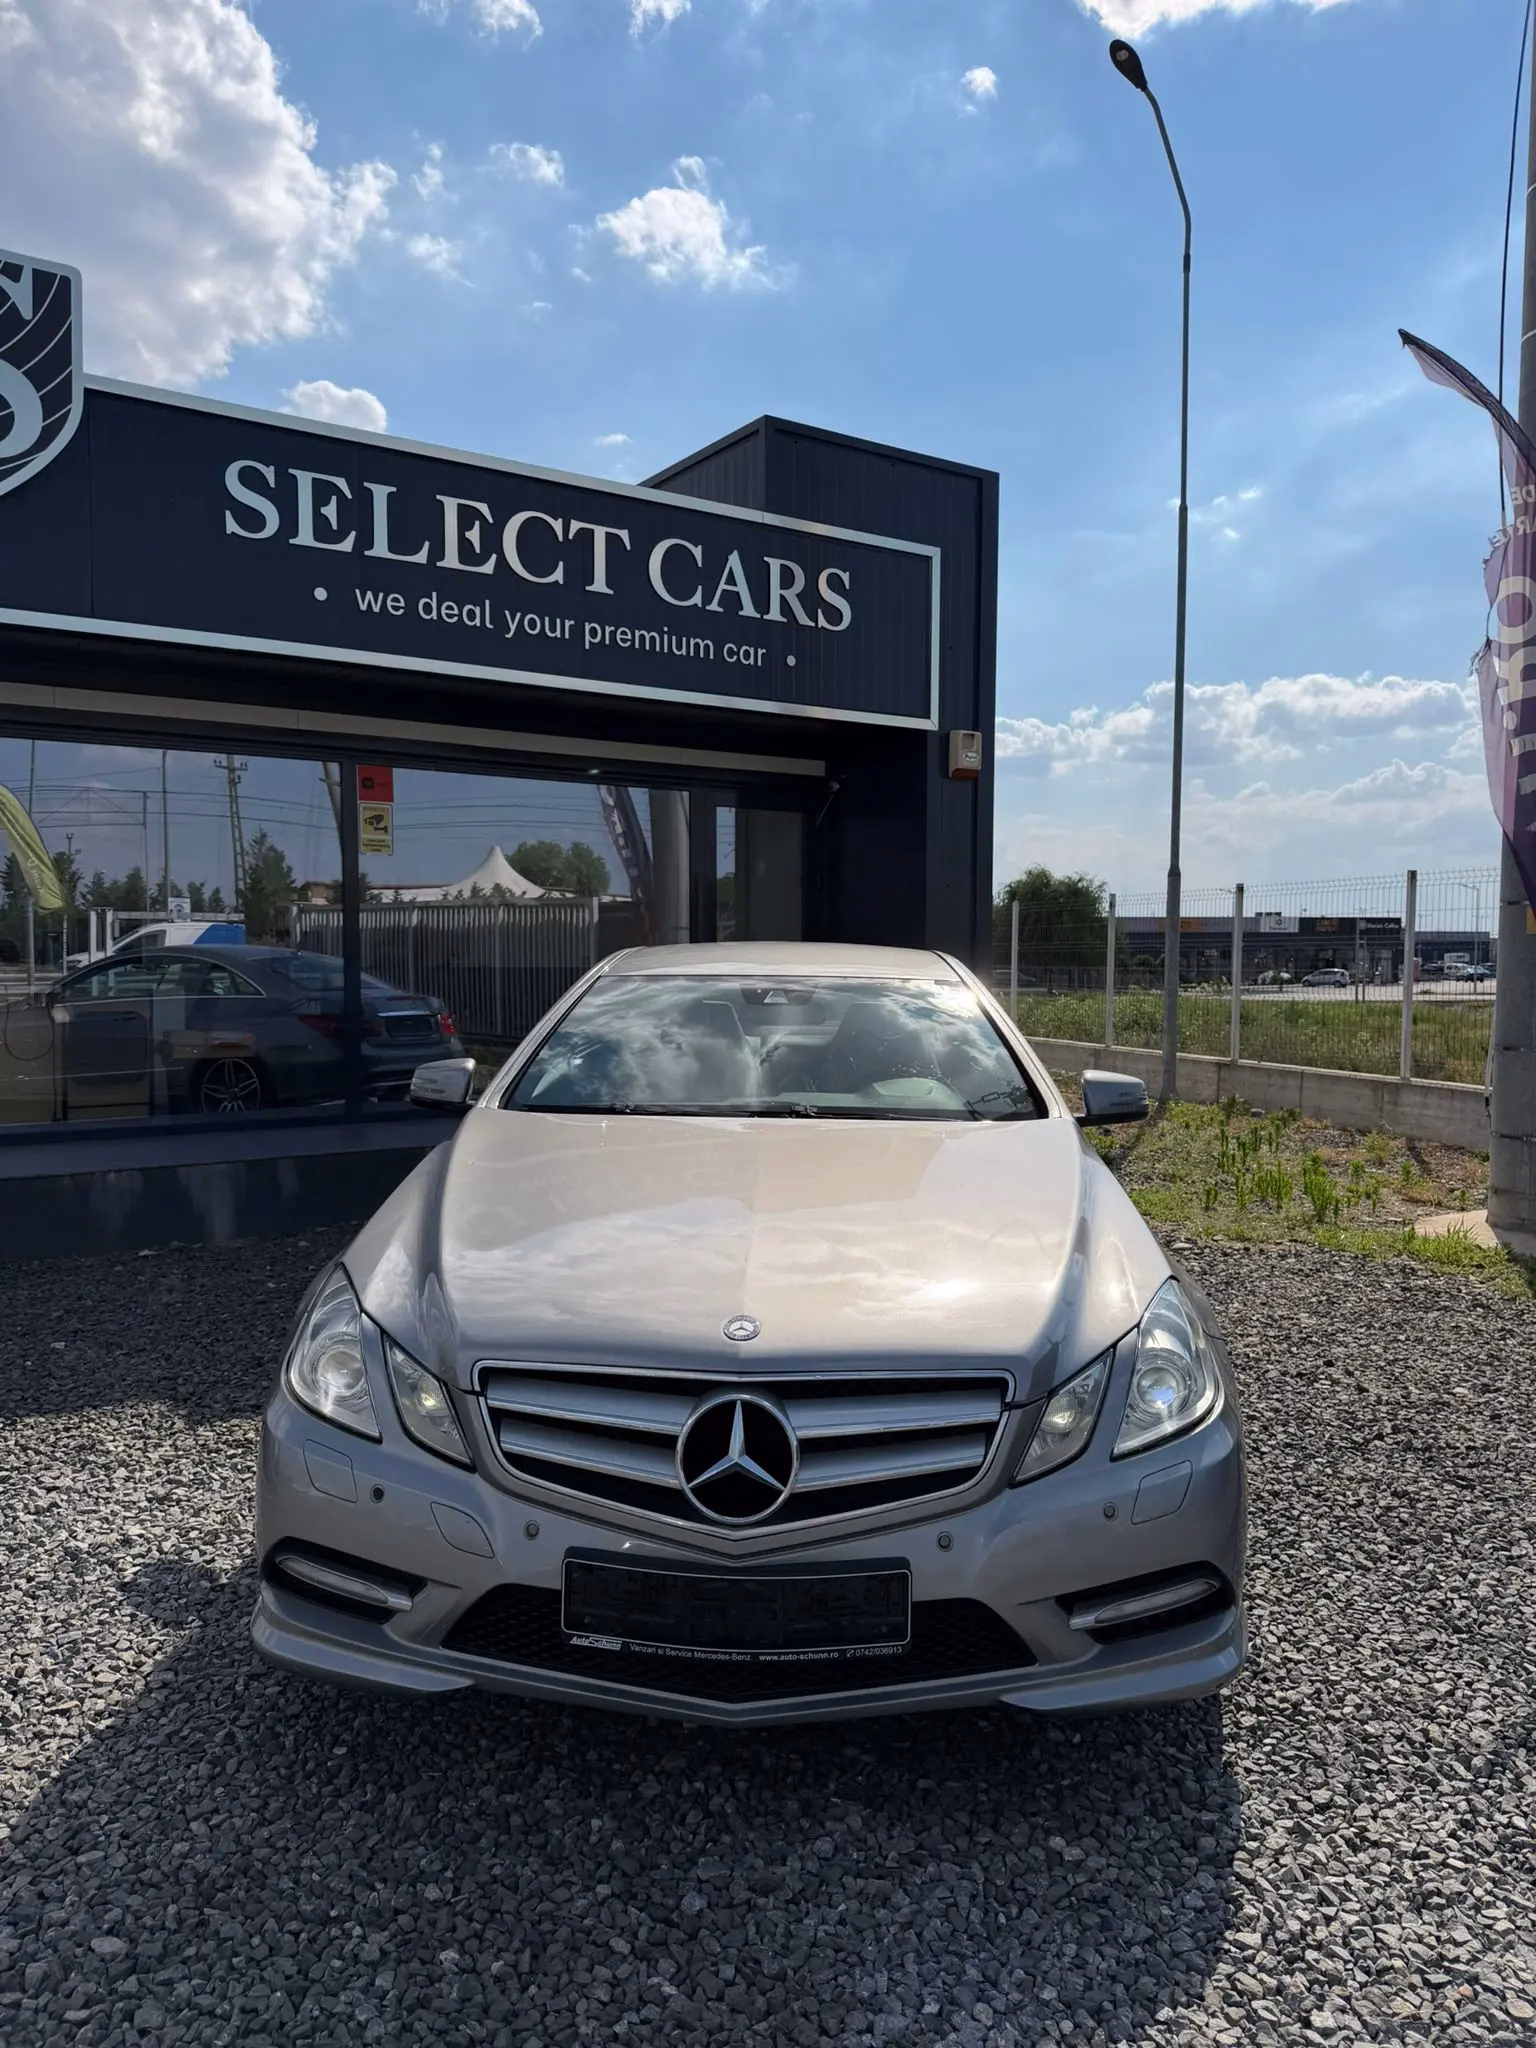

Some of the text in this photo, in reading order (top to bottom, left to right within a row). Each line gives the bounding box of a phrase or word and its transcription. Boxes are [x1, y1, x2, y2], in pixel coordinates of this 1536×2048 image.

[224, 459, 853, 632] SELECT CARS
[355, 587, 768, 668] we deal your premium car
[665, 1648, 693, 1658] Service
[694, 1651, 751, 1661] Mercedes-Benz
[758, 1652, 839, 1661] www.auto-schunn.ro
